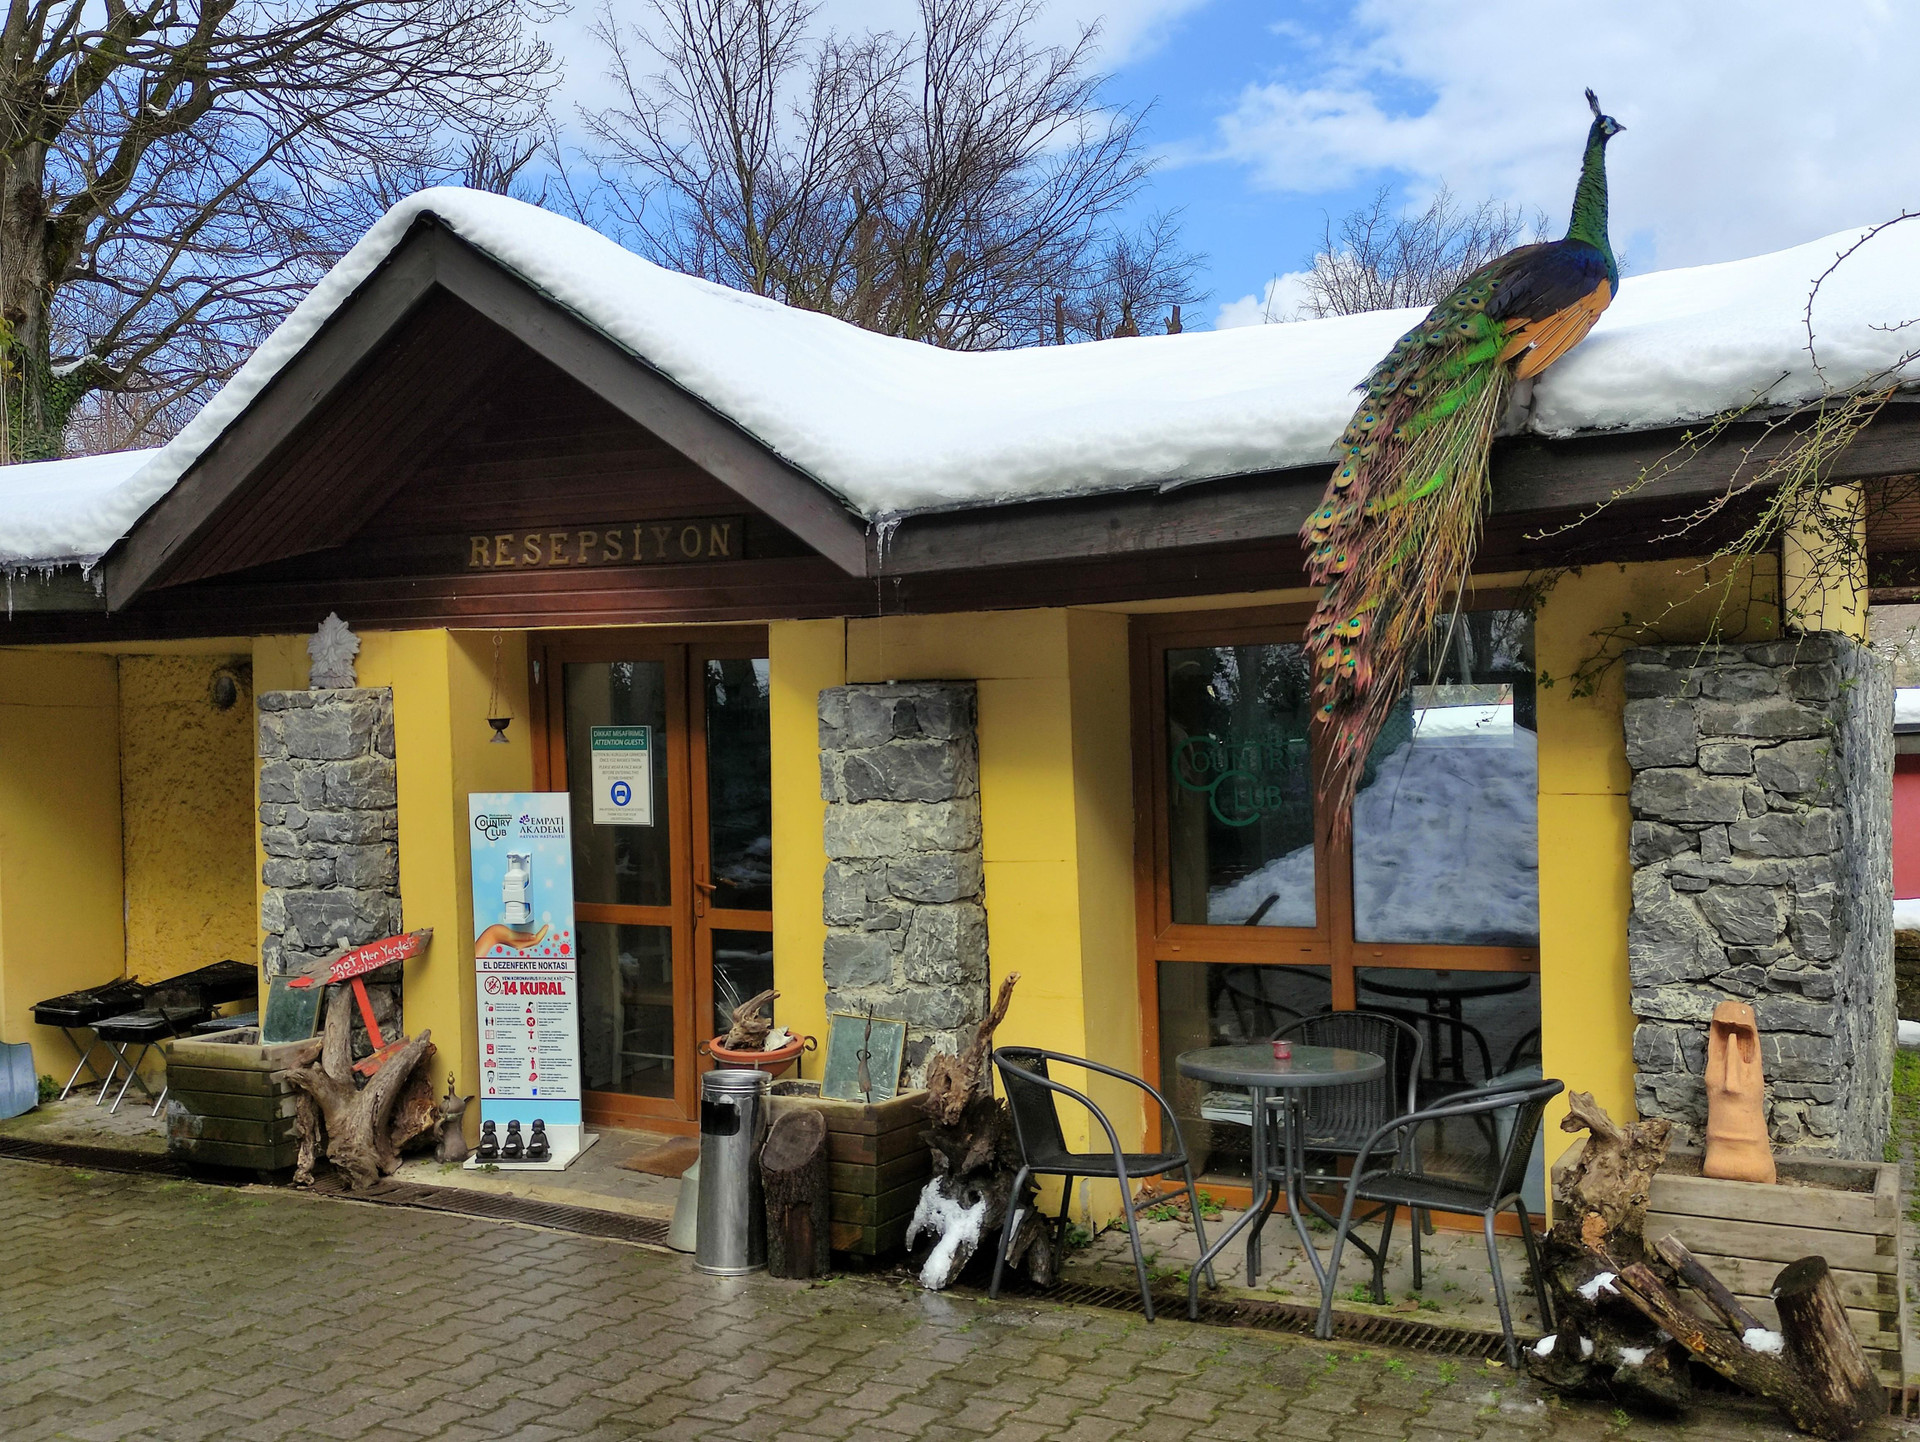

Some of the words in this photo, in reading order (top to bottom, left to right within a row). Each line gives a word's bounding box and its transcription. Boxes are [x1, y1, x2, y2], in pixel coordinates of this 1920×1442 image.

[469, 522, 731, 567] RESEPSİYON
[1209, 769, 1283, 827] CLUB
[475, 815, 511, 831] COUNTRY
[531, 816, 564, 825] EMPATİ
[485, 825, 507, 841] CLUB
[520, 825, 564, 833] AKADEMİ
[360, 950, 379, 964] Her
[483, 962, 492, 970] EL
[493, 962, 537, 970] DEZENFEKTE
[538, 962, 568, 970] NOKTASI
[502, 981, 517, 995] 14
[519, 981, 566, 996] KURAL
